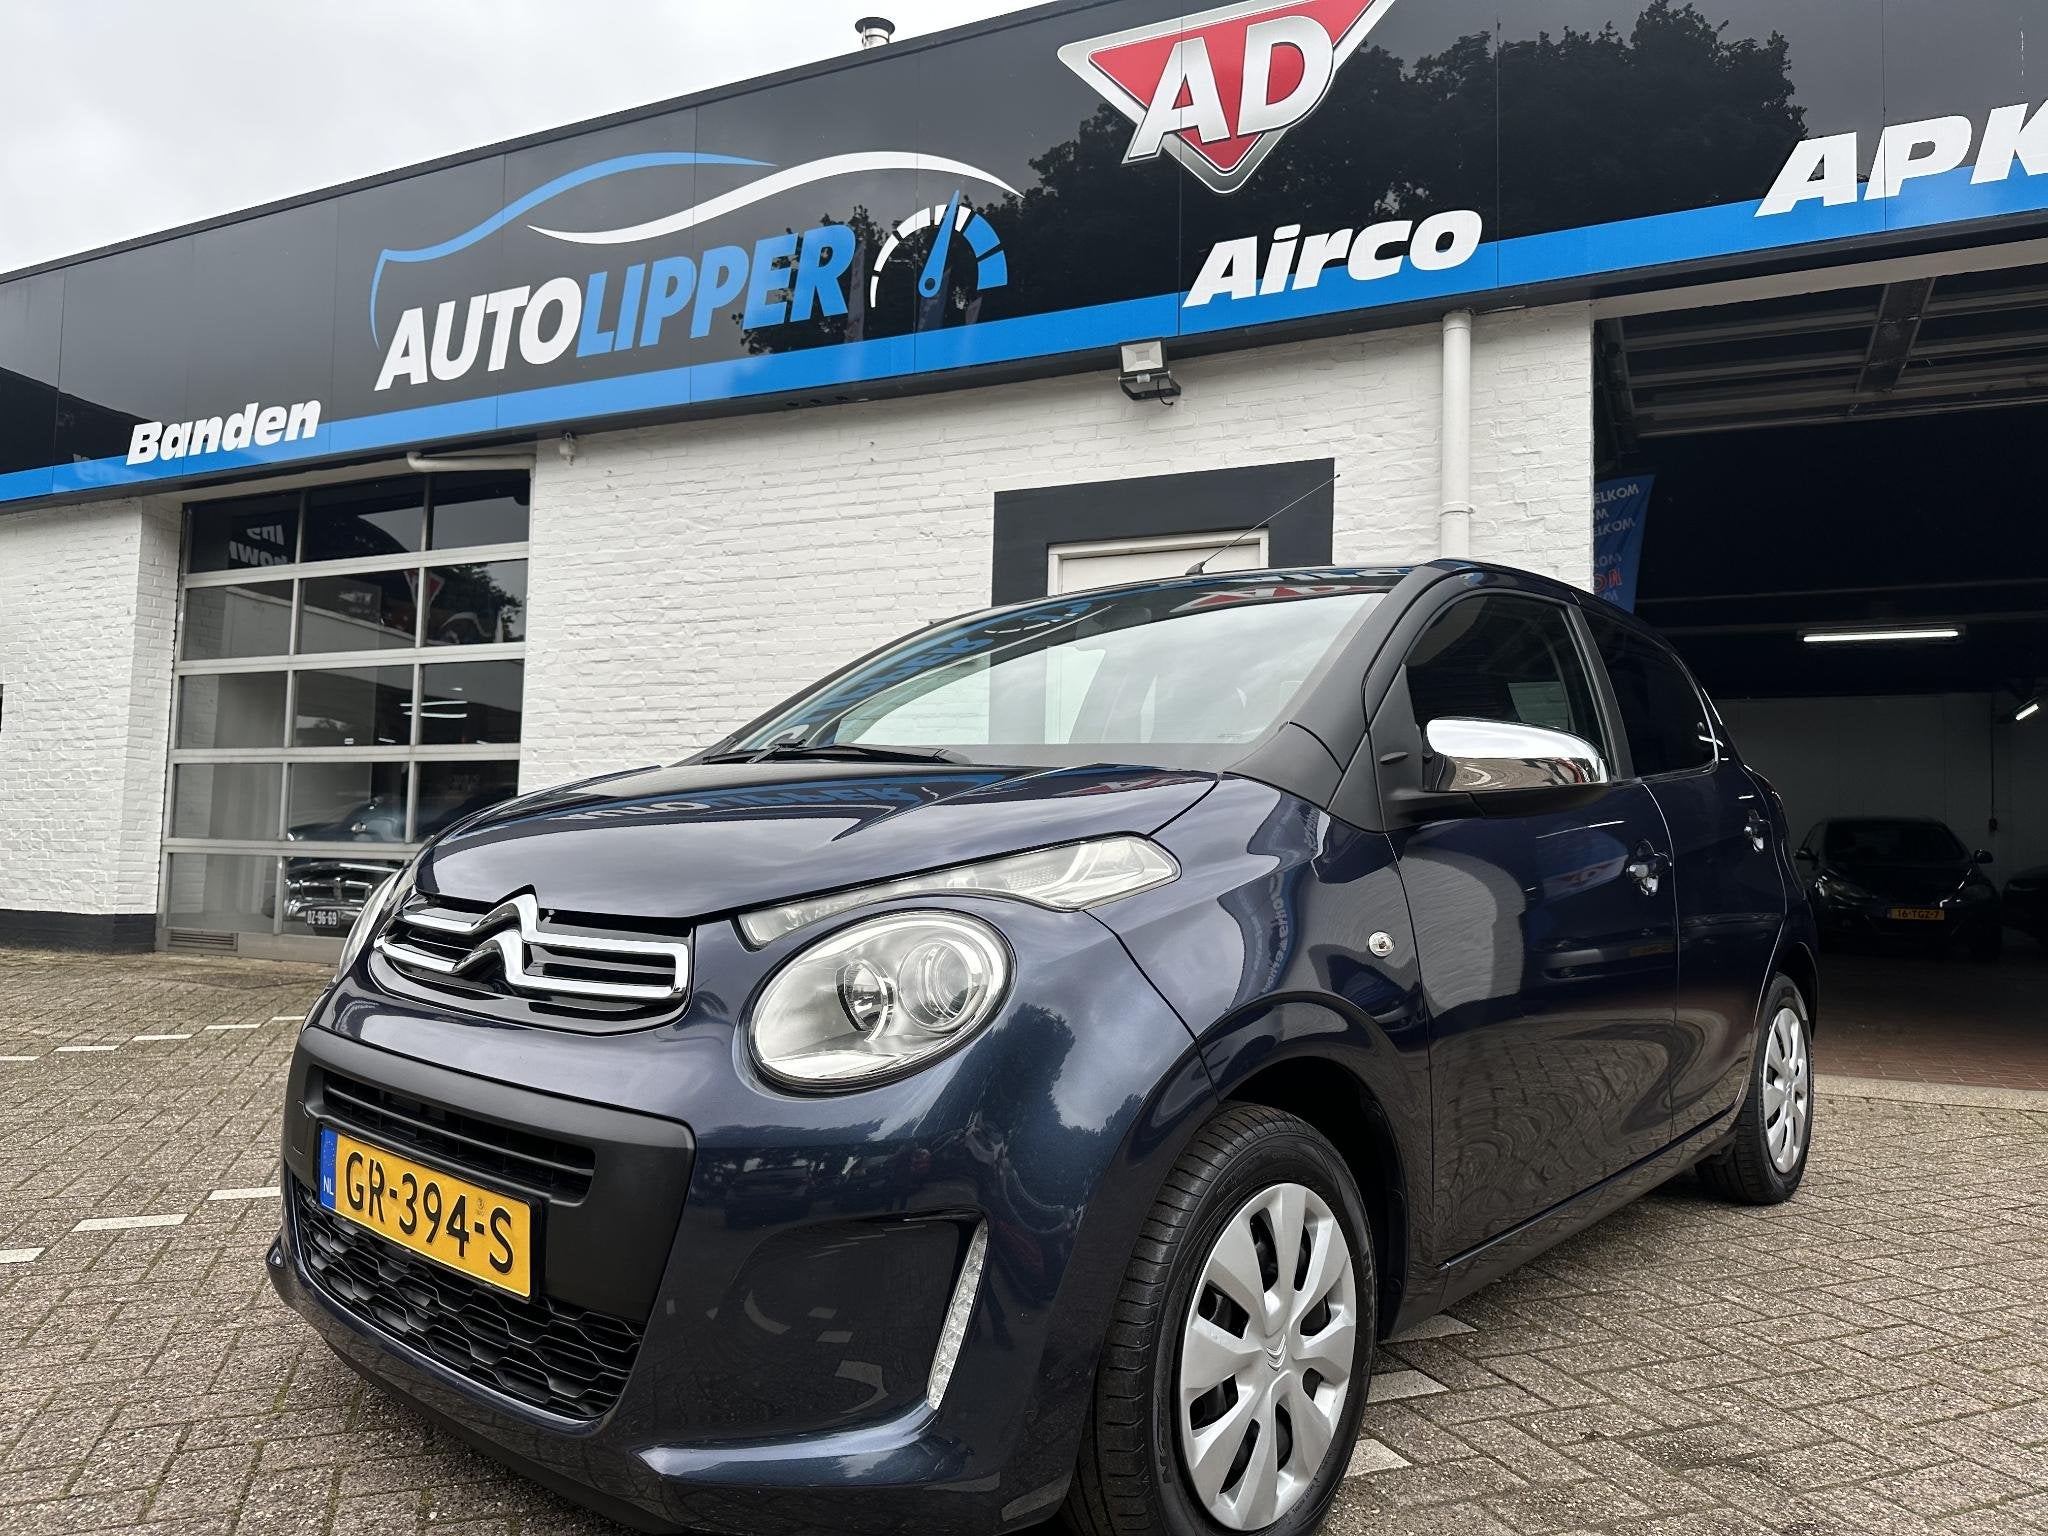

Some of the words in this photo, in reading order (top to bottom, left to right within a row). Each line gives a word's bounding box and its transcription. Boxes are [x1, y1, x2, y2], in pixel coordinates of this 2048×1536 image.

[1128, 15, 1334, 159] AD
[1754, 99, 2048, 217] APK
[374, 225, 856, 391] AUTOLIPPER
[1182, 209, 1483, 308] Airco
[126, 399, 321, 465] Banden
[1593, 517, 1636, 537] ELKOM
[1594, 483, 1639, 504] ELKOM
[323, 1179, 335, 1196] NL
[345, 1151, 514, 1274] GR-394-S
